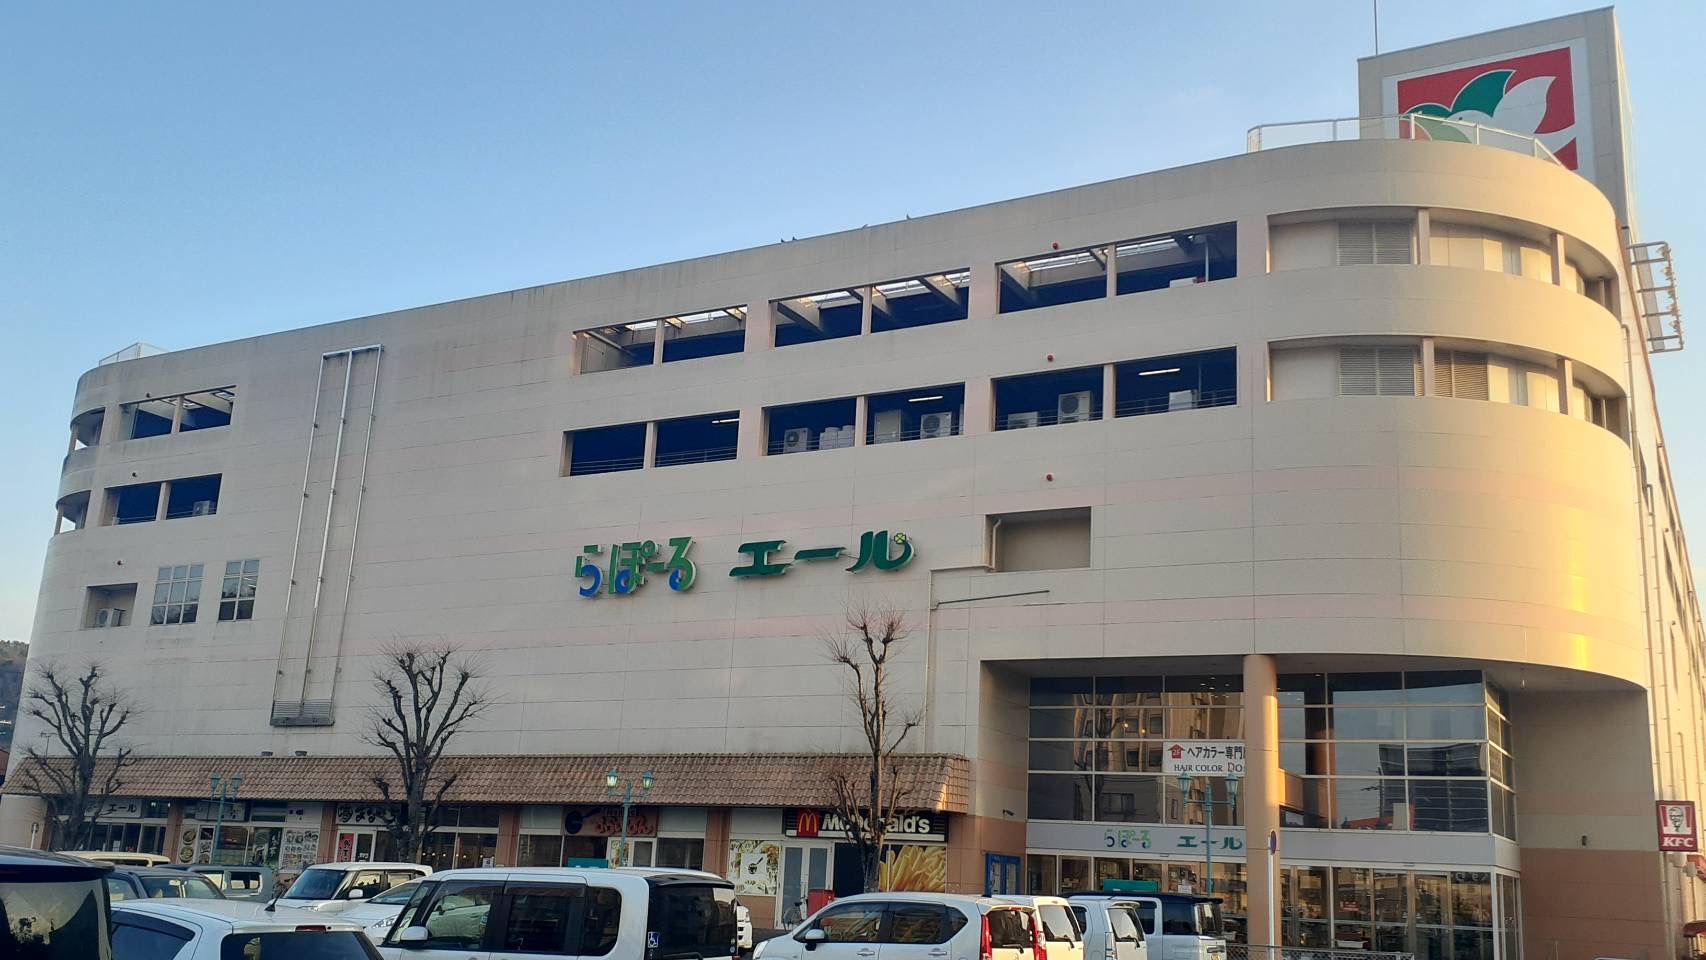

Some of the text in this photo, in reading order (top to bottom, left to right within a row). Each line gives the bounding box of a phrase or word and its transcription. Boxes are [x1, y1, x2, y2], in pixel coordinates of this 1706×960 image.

[575, 530, 916, 598] らぽーる エール
[1187, 746, 1246, 759] ヘアカラー専門
[1174, 764, 1193, 772] HAIR
[1195, 764, 1223, 772] COLOR
[1177, 835, 1243, 850] エール
[1662, 836, 1694, 848] KFC
